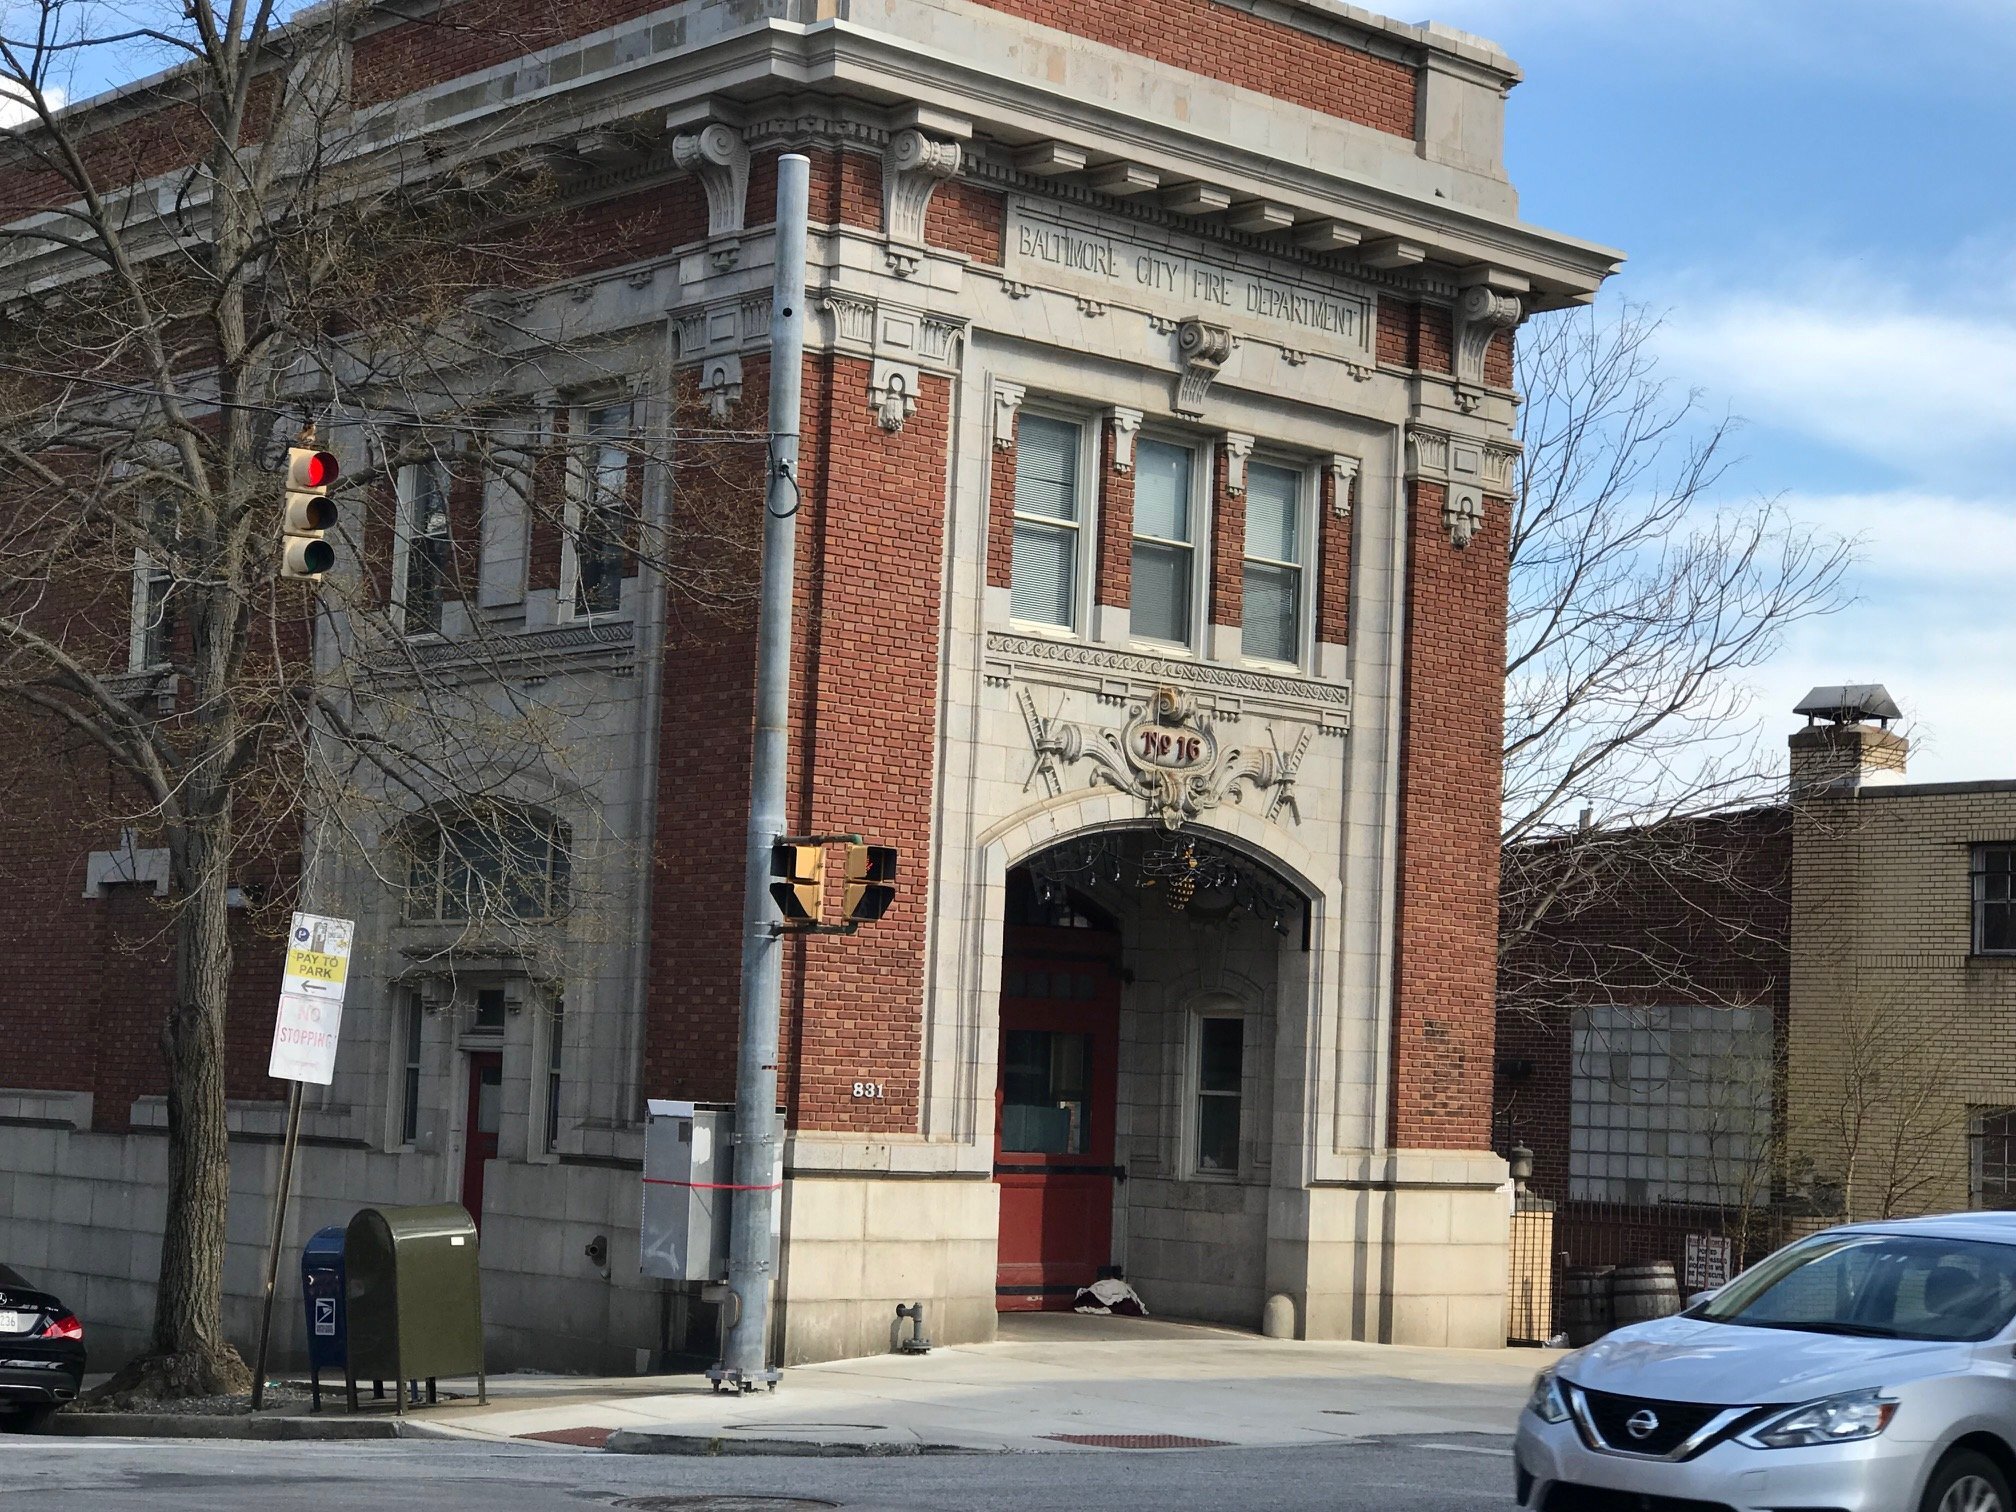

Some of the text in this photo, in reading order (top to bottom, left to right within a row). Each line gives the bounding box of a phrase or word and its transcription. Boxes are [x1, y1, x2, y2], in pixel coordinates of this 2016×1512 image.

[1019, 224, 1358, 337] BALTIMORE CITY FIRE DEPARTMENT
[1176, 736, 1201, 761] 16
[296, 952, 339, 968] PAY TO
[299, 964, 332, 979] PARK
[298, 1004, 321, 1022] NO
[280, 1026, 333, 1049] STOPPING
[853, 1082, 884, 1098] 831
